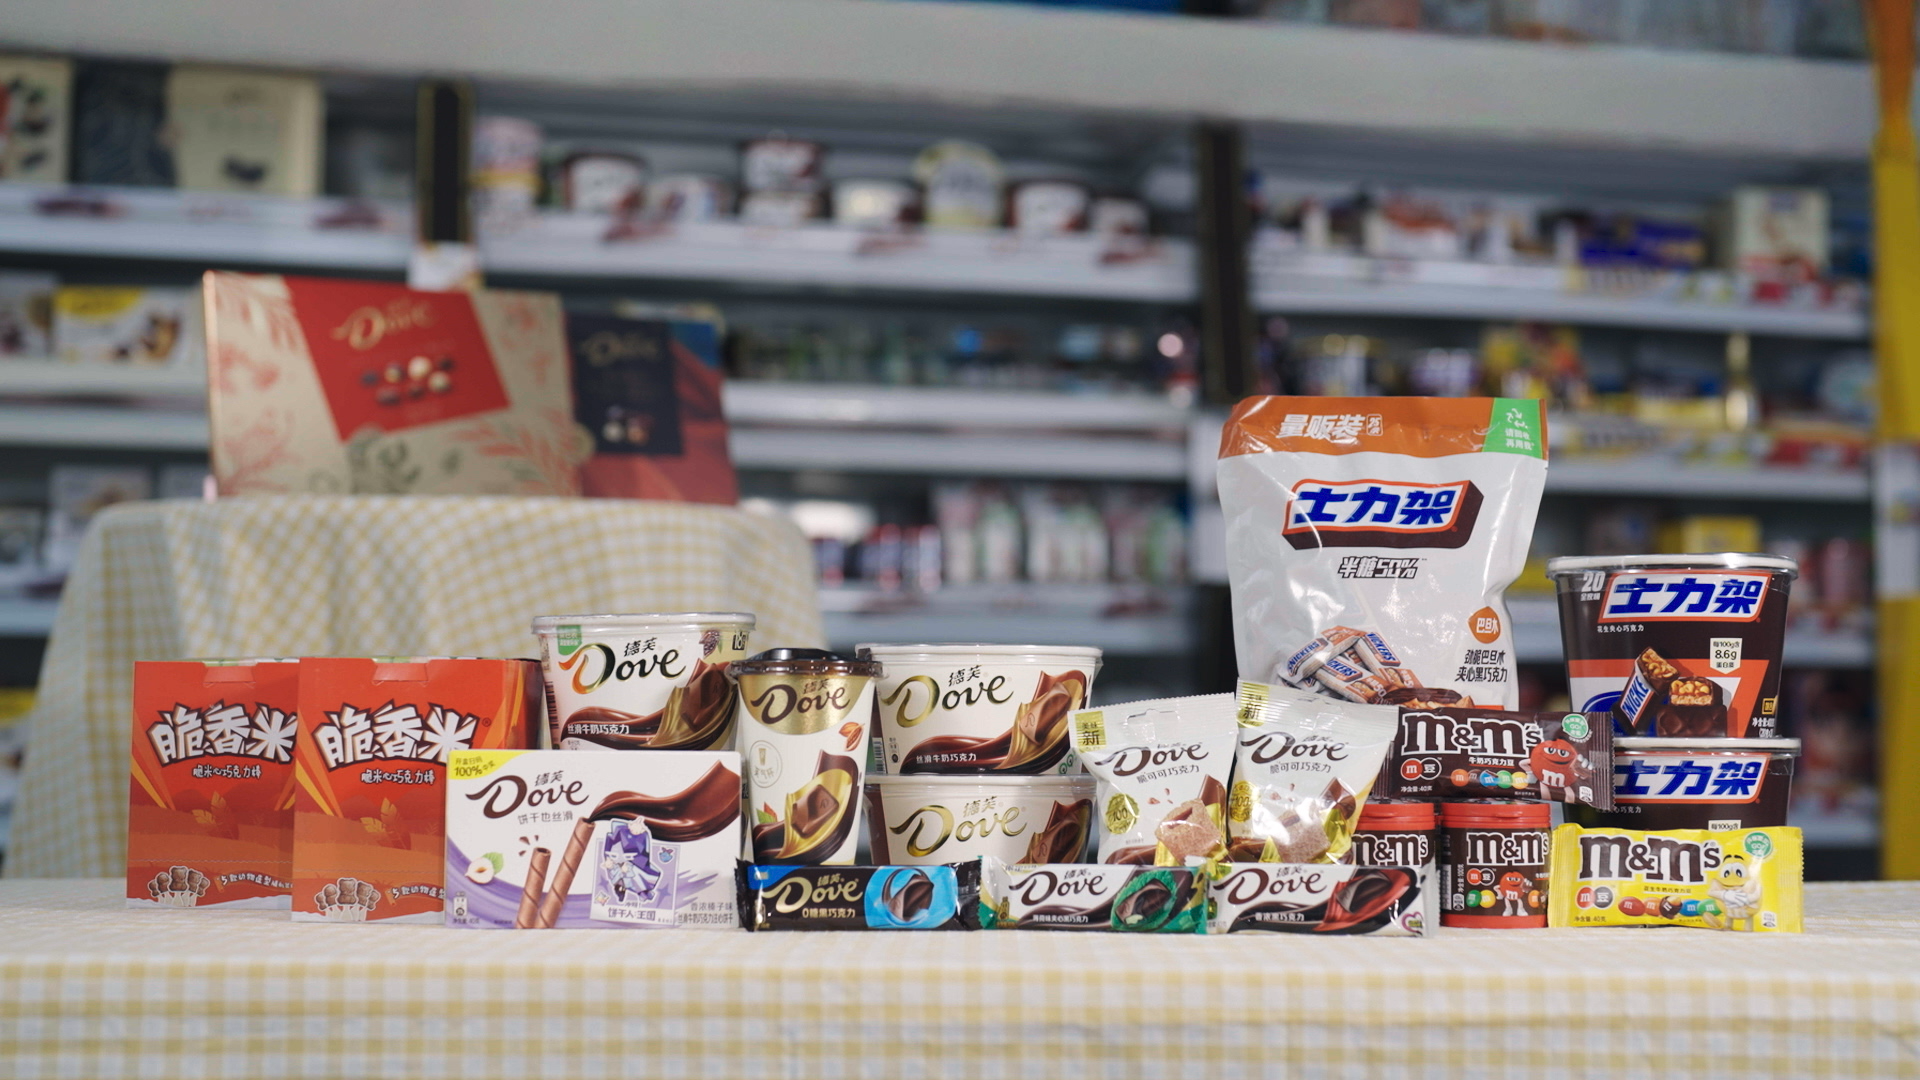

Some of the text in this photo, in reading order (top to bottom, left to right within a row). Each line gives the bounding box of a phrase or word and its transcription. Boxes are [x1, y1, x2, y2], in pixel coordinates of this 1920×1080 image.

[1276, 413, 1365, 444] 量贩装
[1294, 486, 1457, 525] 士力架
[1338, 556, 1420, 579] 半糖50%
[1582, 571, 1606, 592] 20
[1608, 577, 1764, 615] 士力架
[1476, 617, 1499, 635] 巴旦木
[1597, 625, 1644, 634] 花生夹心巧克力
[623, 637, 658, 657] 德芙
[1287, 640, 1320, 672] SNICKERS
[1714, 649, 1737, 661] 8.6g
[1464, 649, 1505, 666] 劲脆巴旦木
[558, 643, 687, 695] Dove
[948, 665, 983, 688] 德芙
[1455, 666, 1508, 683] 夹心黑巧克力
[803, 678, 830, 695] 德芙
[751, 684, 851, 725] Dove
[881, 675, 1015, 728] Dove
[1243, 703, 1262, 720] 新
[146, 699, 297, 766] 脆香米
[312, 698, 481, 772] 脆香米
[567, 723, 630, 736] 丝滑牛奶巧克力
[1082, 730, 1100, 746] 新
[1401, 712, 1544, 758] m&m's
[1240, 731, 1349, 765] Dove
[916, 753, 977, 764] 丝滑牛奶巧克力
[1094, 743, 1209, 776] Dove
[1269, 761, 1332, 775] 脆可可巧克力
[1468, 757, 1515, 767] 牛奶巧克力豆
[192, 764, 262, 779] 脆米心巧克力棒
[361, 769, 436, 785] 脆米心巧克力棒
[1136, 764, 1200, 784] 脆可可巧克力
[1406, 764, 1418, 774] m
[1423, 763, 1436, 774] 豆
[1615, 759, 1764, 796] 士力架
[534, 770, 565, 787] 德芙
[1542, 769, 1566, 788] m
[465, 775, 590, 820] Dove
[962, 796, 998, 818] 德芙
[518, 811, 574, 826] 饼干也丝滑
[889, 805, 1028, 857] Dove
[1577, 834, 1722, 885] m&m's
[761, 875, 864, 914] Dove
[1008, 870, 1108, 906] Dove
[1213, 867, 1328, 905] Dove
[1507, 891, 1518, 899] m
[691, 902, 733, 911] 香浓榛子味
[1580, 894, 1590, 902] m
[1597, 893, 1609, 902] 豆
[802, 907, 856, 919] 0糖黑巧克力
[1255, 911, 1305, 922] 香浓黑巧克力
